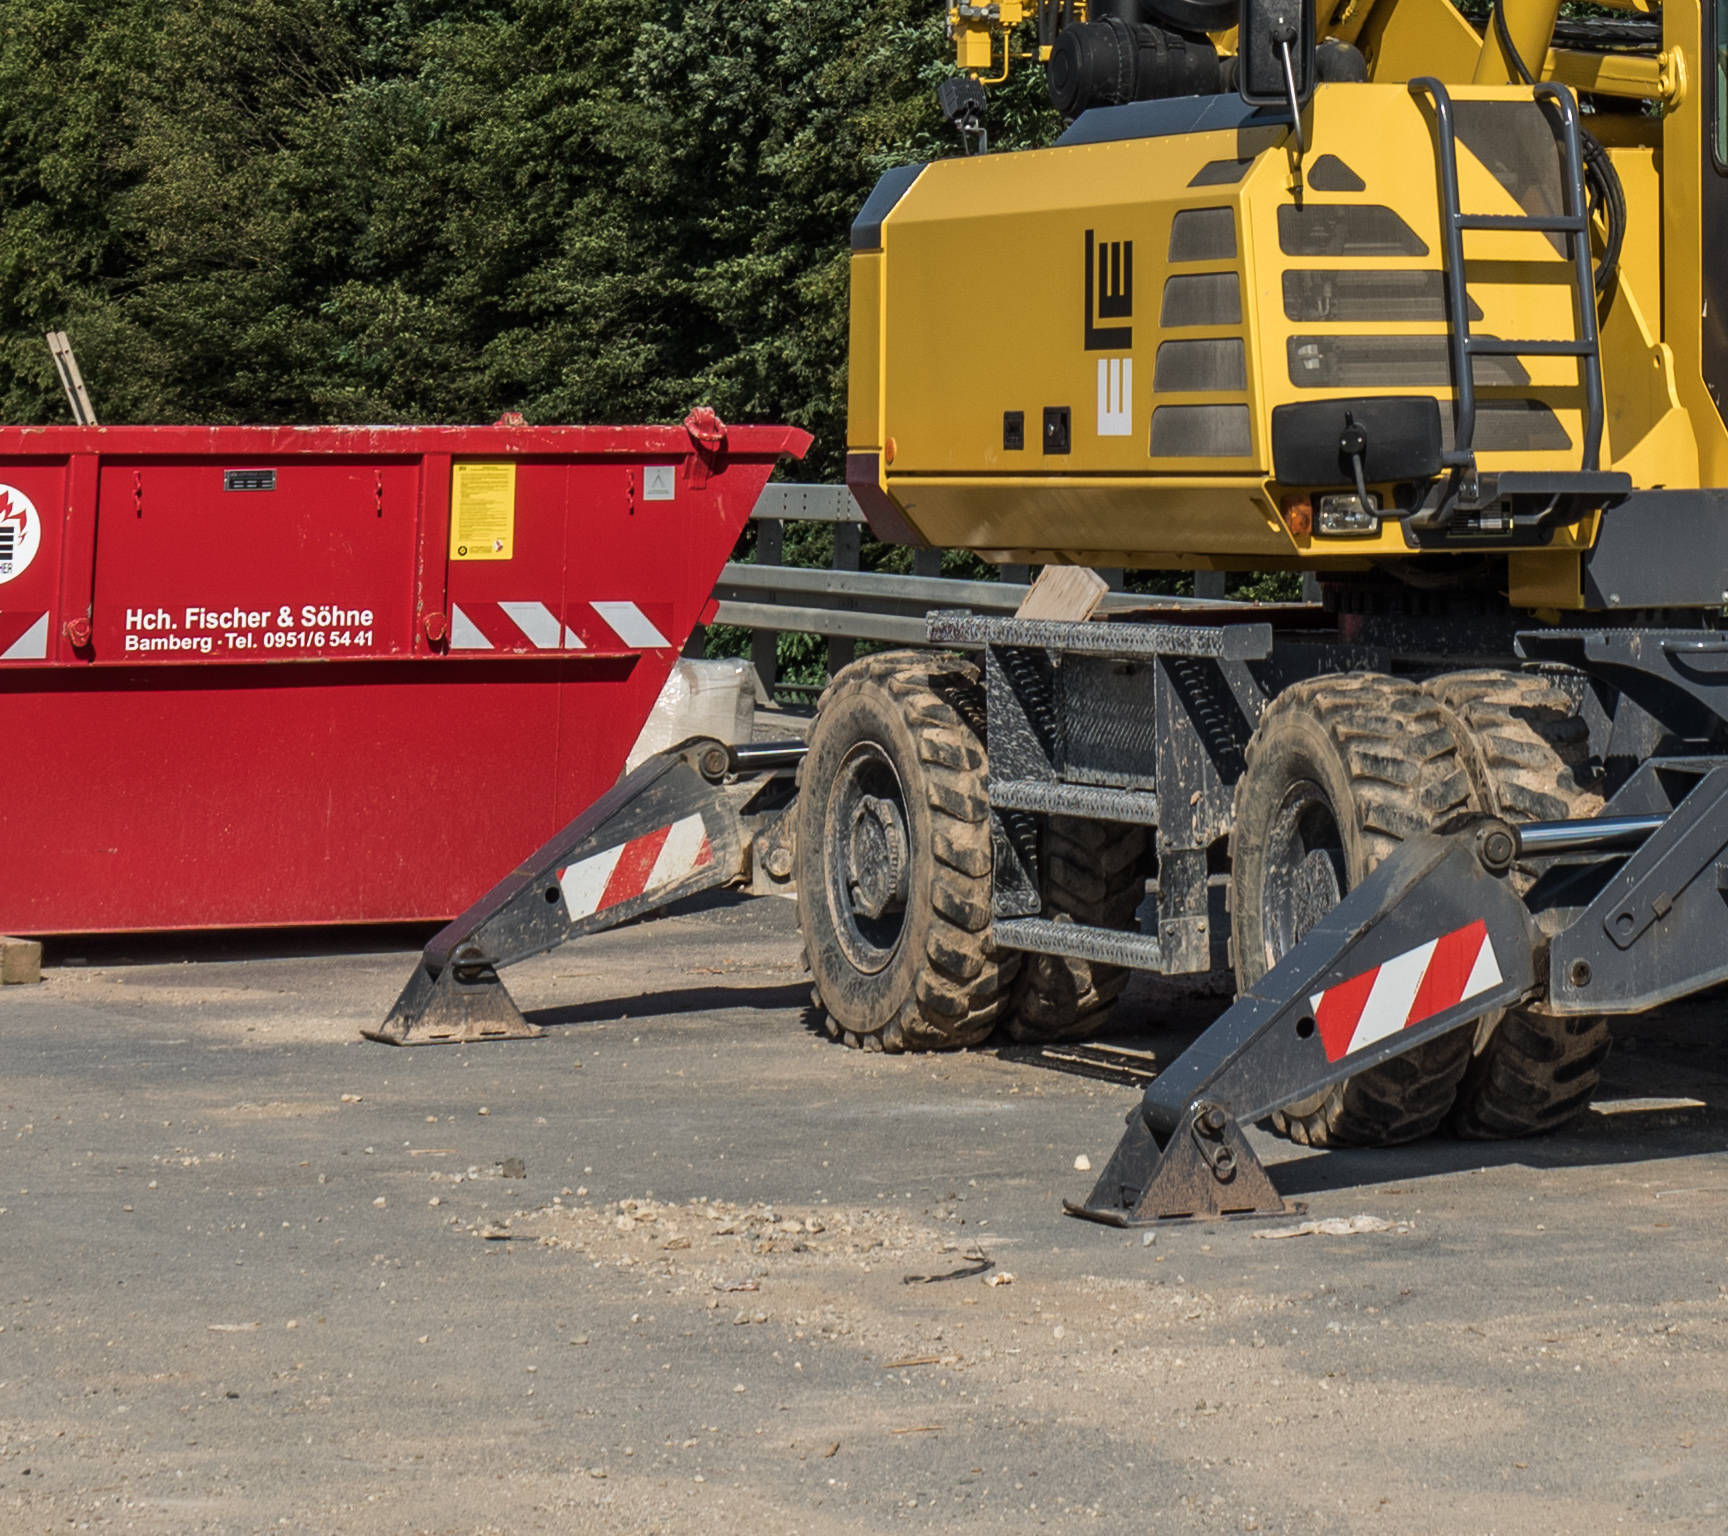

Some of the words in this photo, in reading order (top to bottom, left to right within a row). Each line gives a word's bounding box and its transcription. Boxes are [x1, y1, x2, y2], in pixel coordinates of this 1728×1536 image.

[125, 608, 178, 630] Hch.
[185, 606, 272, 630] Fischer
[276, 605, 295, 629] &
[300, 605, 375, 628] Söhne
[124, 634, 213, 654] Bamberg
[224, 632, 258, 649] Tel.
[262, 631, 326, 649] 0951/6
